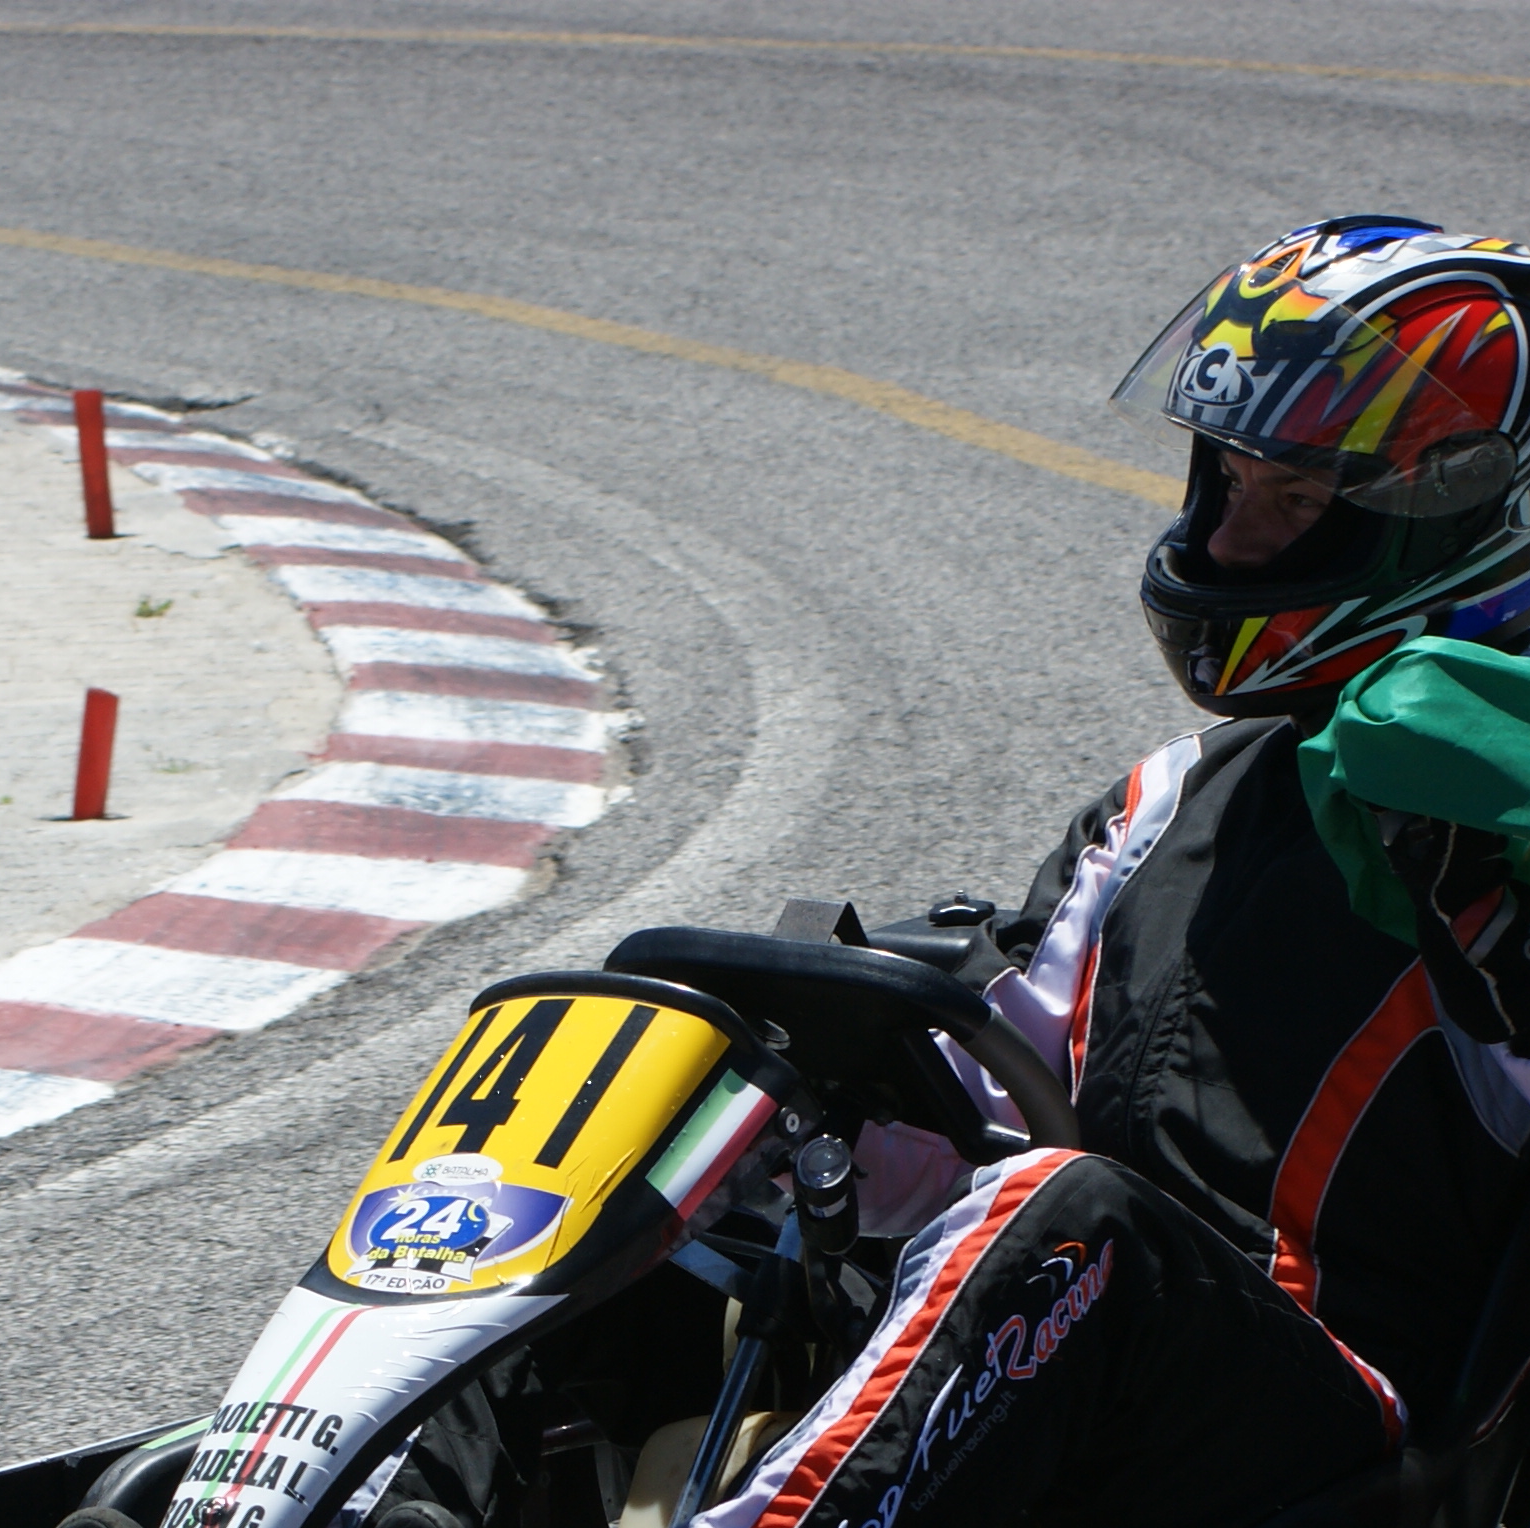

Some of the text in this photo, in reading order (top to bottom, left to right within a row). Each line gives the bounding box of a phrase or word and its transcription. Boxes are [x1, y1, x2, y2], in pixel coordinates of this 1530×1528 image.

[389, 998, 660, 1168] 141
[380, 1199, 469, 1241] 24
[394, 1231, 441, 1244] horas
[368, 1246, 390, 1260] da
[386, 1274, 446, 1292] EDÇÃO
[987, 1238, 1114, 1381] Racing
[311, 1413, 344, 1457] G.
